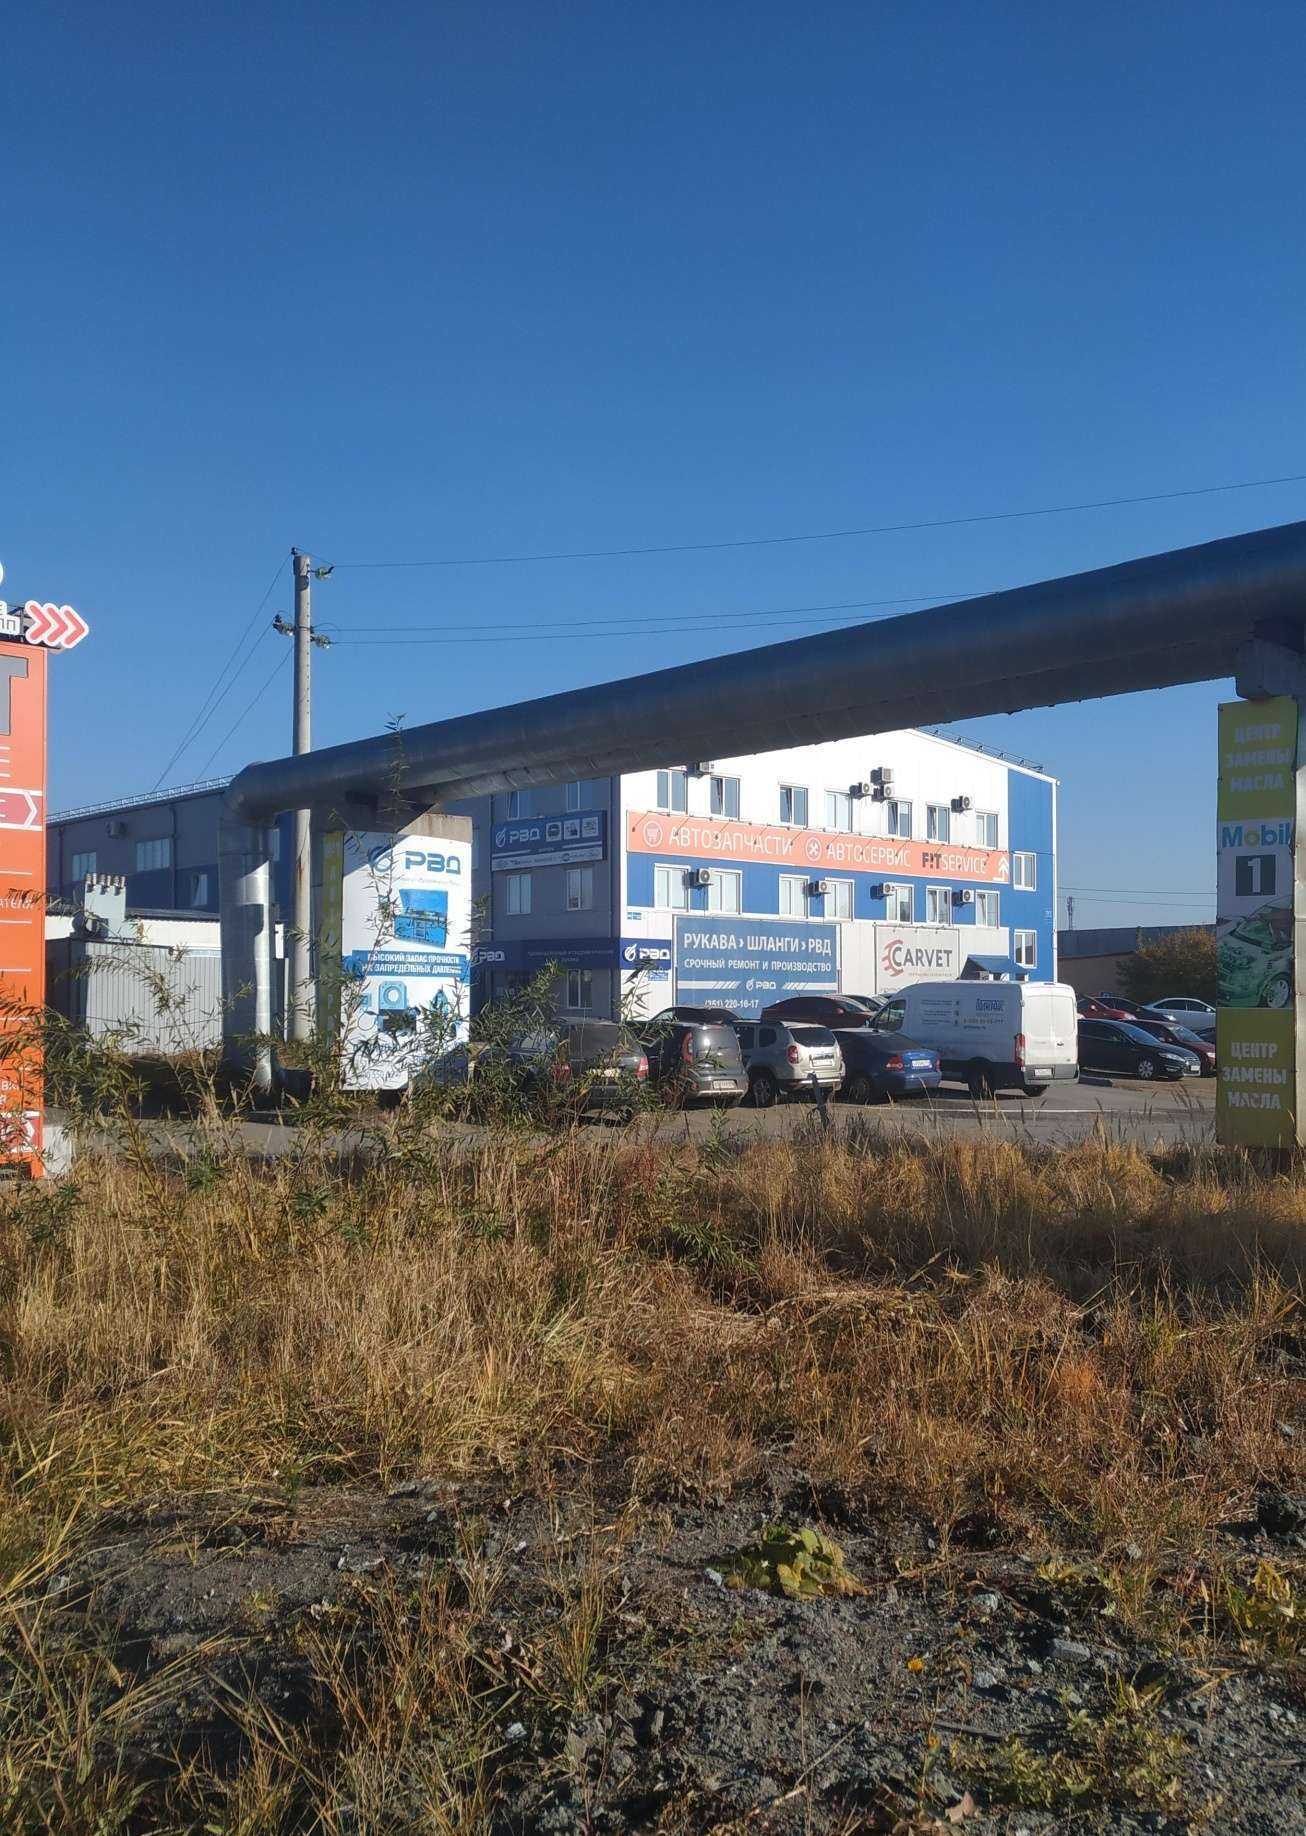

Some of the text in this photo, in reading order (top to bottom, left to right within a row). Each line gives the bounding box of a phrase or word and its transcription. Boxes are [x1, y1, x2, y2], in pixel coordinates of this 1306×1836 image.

[509, 823, 540, 843] РВД
[1221, 821, 1291, 849] Mobil
[669, 826, 913, 869] АВТОЗАПЧАСТИ АВТОСЕРВИС
[404, 850, 462, 876] РВД
[1246, 857, 1262, 894] 1
[639, 947, 671, 961] РВД
[683, 932, 832, 957] РУКАВА ШЛАНГИ РВД
[683, 957, 832, 974] СРОЧНЫЙ РЕМОНТ И ПРОИЗВОДСТВО
[892, 946, 953, 968] CARVET
[1230, 1042, 1279, 1060] ЦЕНТР
[1222, 1066, 1287, 1085] ЗАМЕНЫ
[1228, 1089, 1281, 1110] МАСЛА
